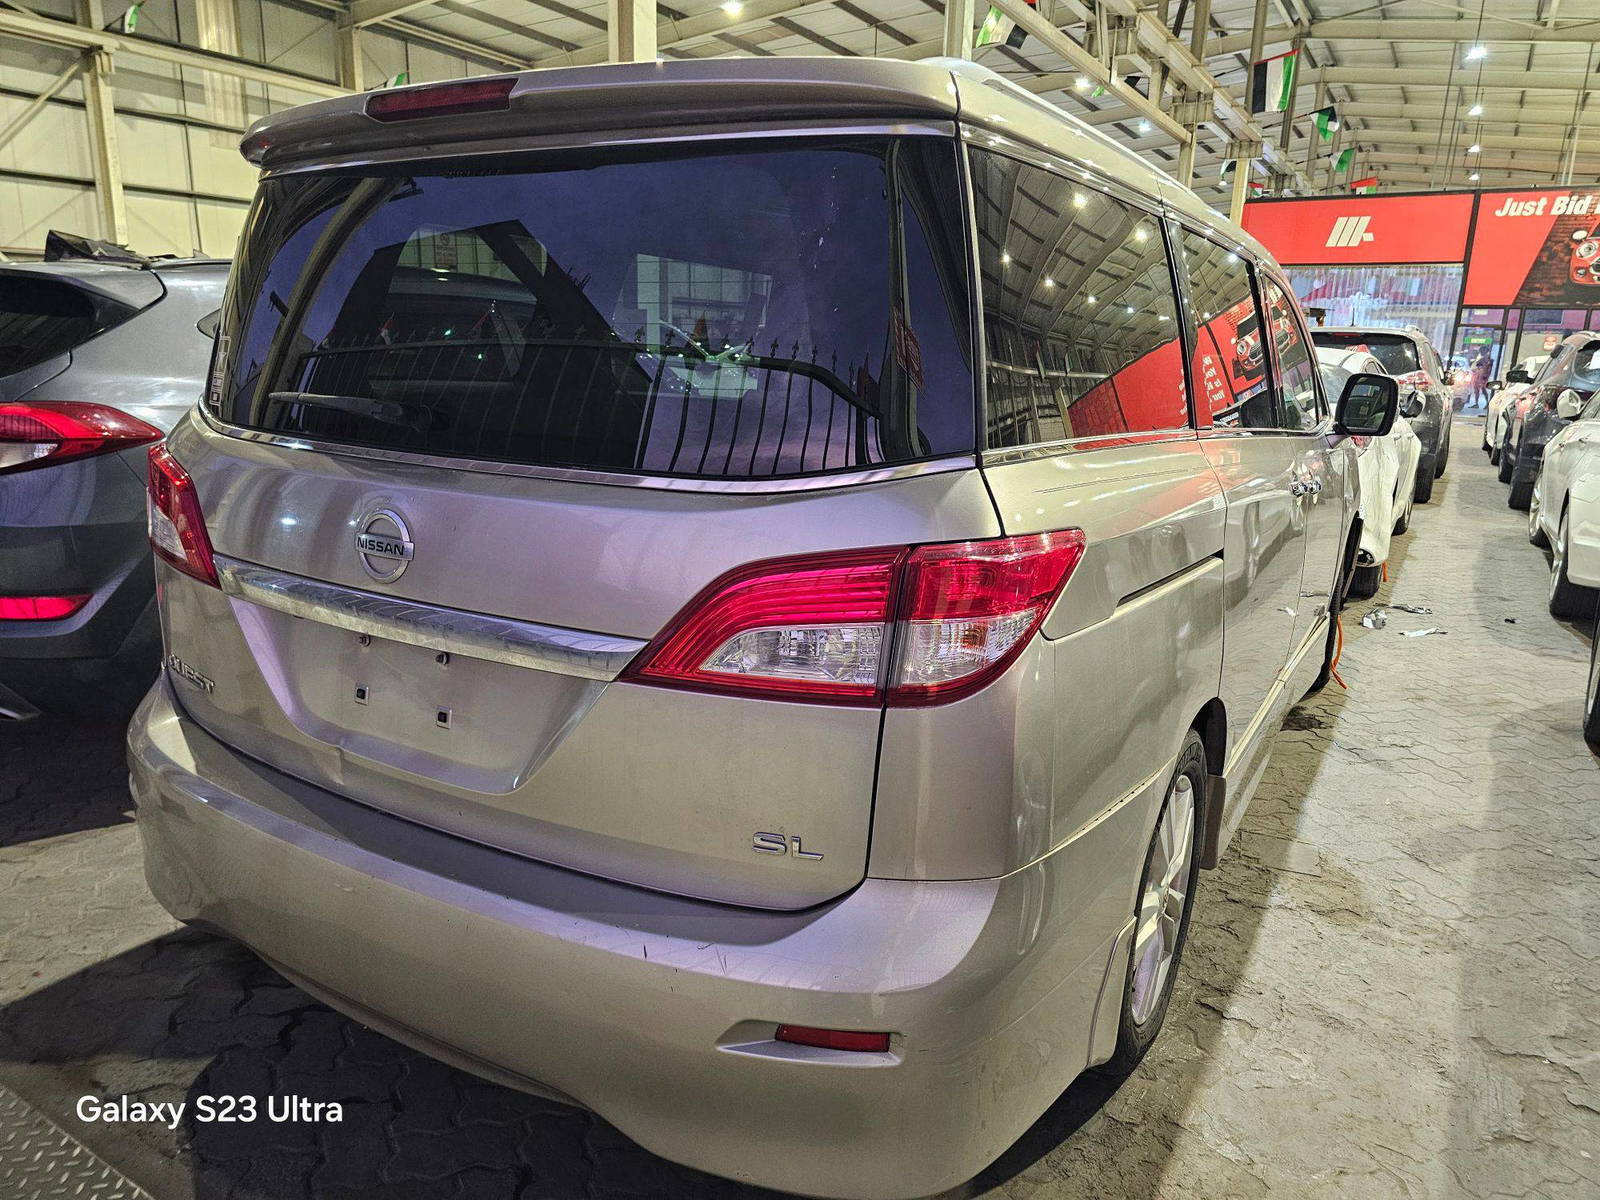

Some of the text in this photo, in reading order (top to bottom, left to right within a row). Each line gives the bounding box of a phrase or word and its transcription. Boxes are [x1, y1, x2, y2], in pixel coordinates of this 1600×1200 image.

[1495, 198, 1547, 216] Just
[1550, 196, 1592, 216] Bid
[357, 537, 404, 556] NISSAN
[168, 652, 215, 695] QUEST
[753, 832, 824, 860] SL
